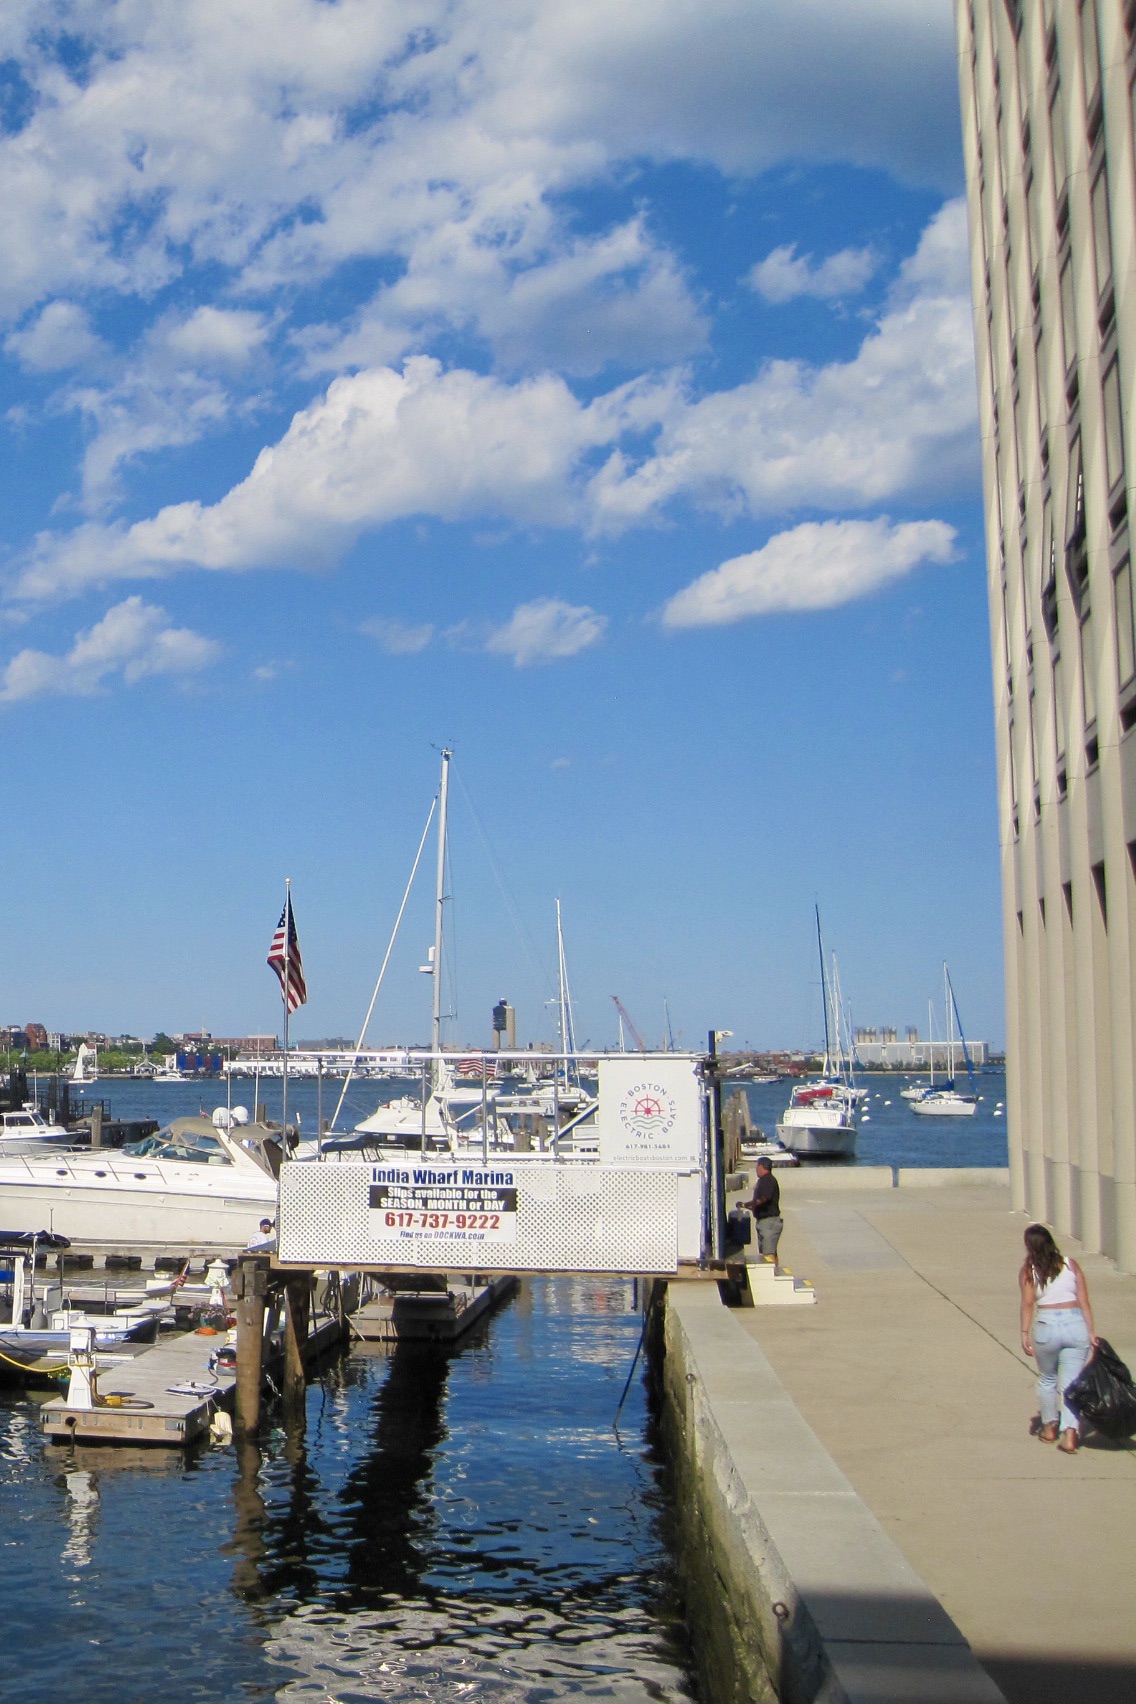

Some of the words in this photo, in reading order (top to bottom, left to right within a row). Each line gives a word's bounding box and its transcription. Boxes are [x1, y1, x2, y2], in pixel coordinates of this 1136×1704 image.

[627, 1083, 668, 1097] BOSTON
[620, 1102, 654, 1139] ELECTRIC
[661, 1099, 677, 1134] BOATS
[372, 1168, 409, 1183] India
[412, 1169, 459, 1185] Wharf
[461, 1169, 514, 1186] Marina
[388, 1187, 413, 1198] Slips
[414, 1188, 462, 1200] available
[463, 1189, 480, 1199] for
[480, 1189, 498, 1200] the
[427, 1199, 467, 1211] MONTH
[469, 1201, 482, 1210] or
[483, 1200, 506, 1211] DAY
[384, 1211, 501, 1230] 617-737-9222
[399, 1230, 414, 1239] Find
